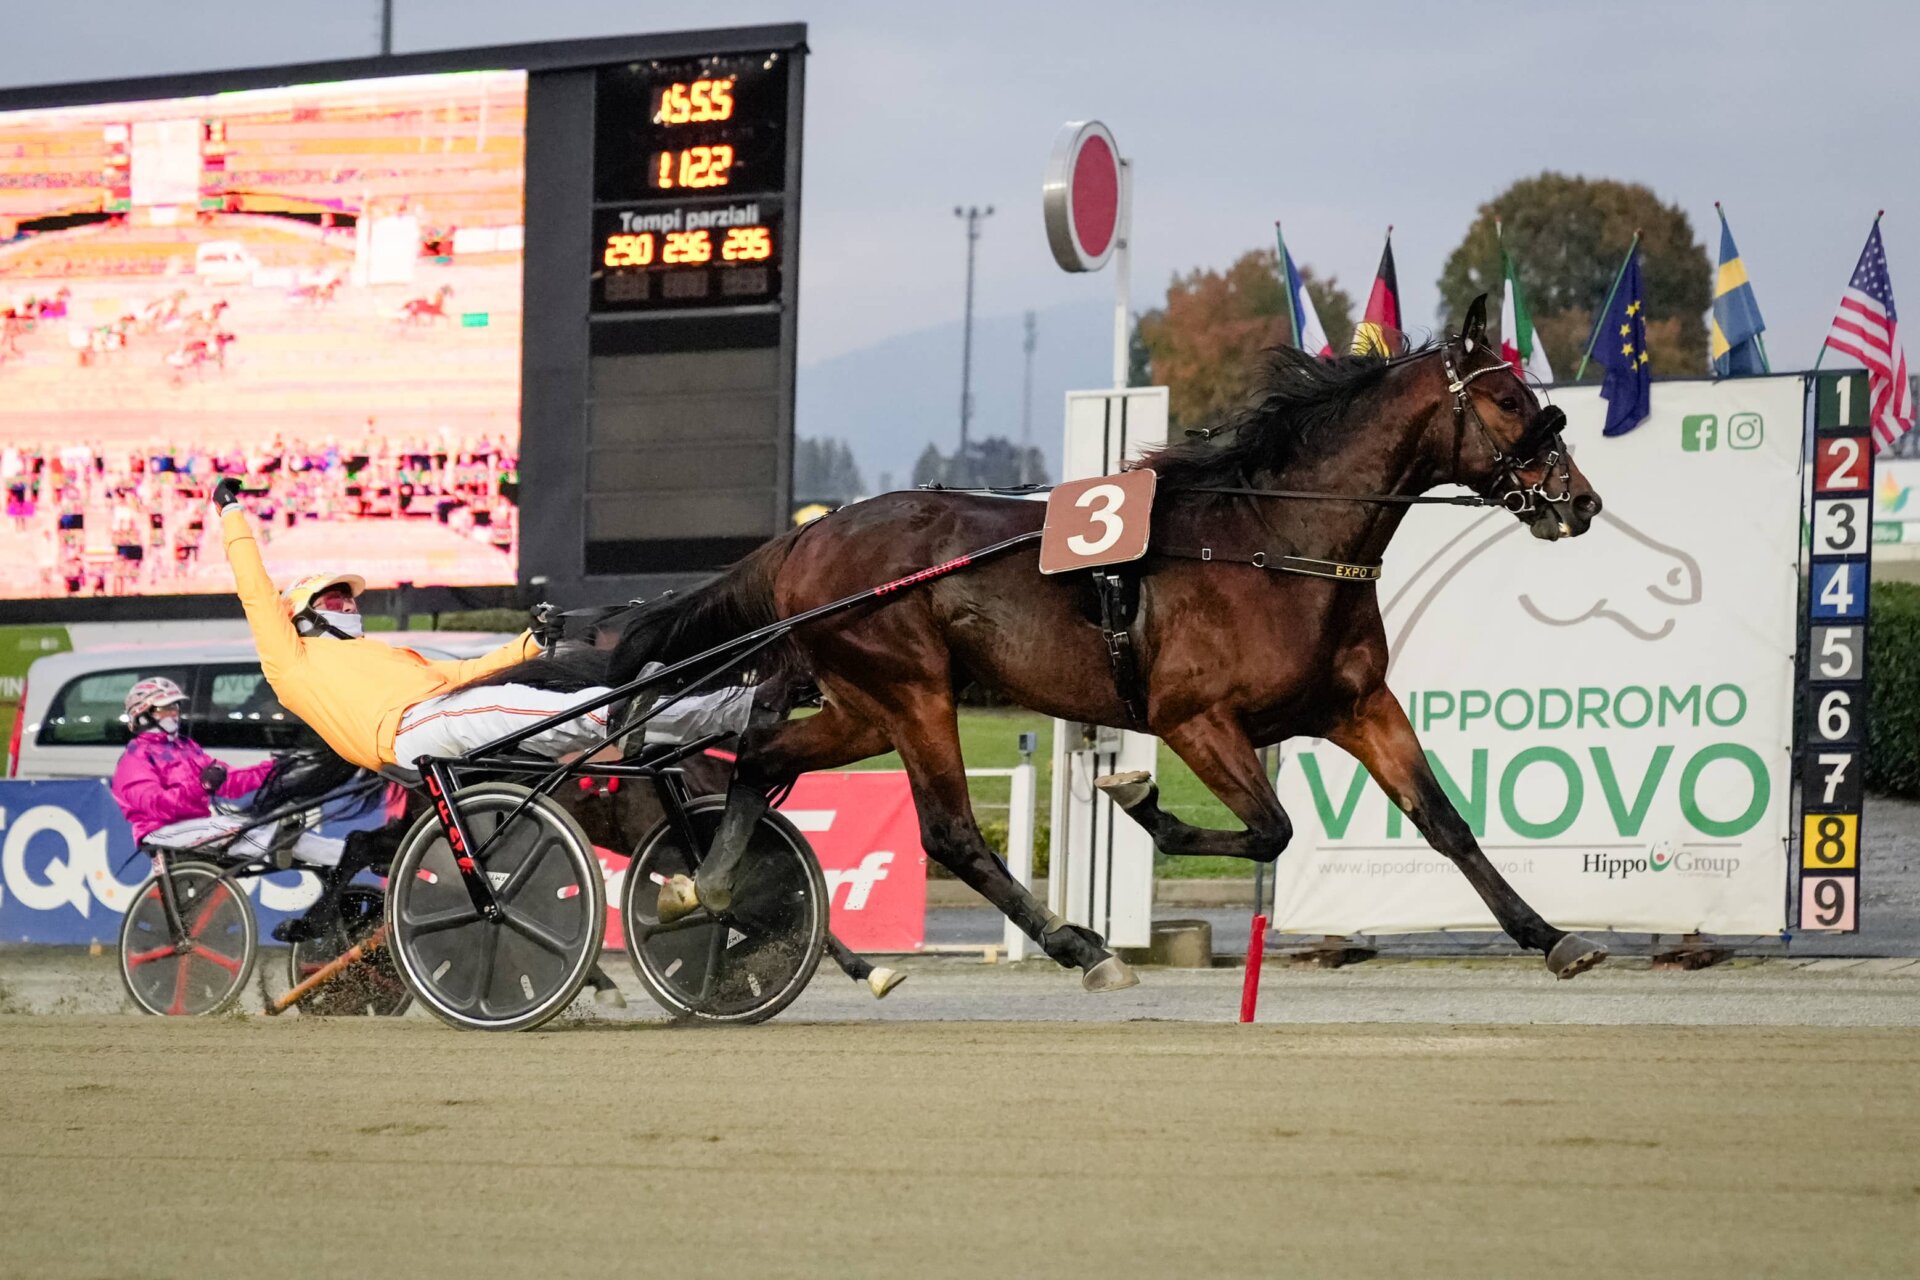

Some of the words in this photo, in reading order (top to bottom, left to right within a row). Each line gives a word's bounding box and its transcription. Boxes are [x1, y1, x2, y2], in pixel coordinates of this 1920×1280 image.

[619, 208, 683, 234] Tempi
[686, 204, 760, 231] parziali
[1836, 376, 1851, 426] 1
[1826, 438, 1860, 488] 2
[1067, 484, 1125, 556] 3
[1825, 503, 1856, 550] 3
[1335, 565, 1368, 578] EXPO
[1820, 564, 1853, 615] 4
[1819, 627, 1853, 677] 5
[1409, 683, 1748, 732] IPPODROMO
[1817, 690, 1851, 740] 6
[1818, 753, 1851, 803] 7
[1815, 816, 1846, 864] 8
[1582, 853, 1647, 879] Hippo
[1674, 852, 1740, 878] Group
[1814, 879, 1845, 926] 9
